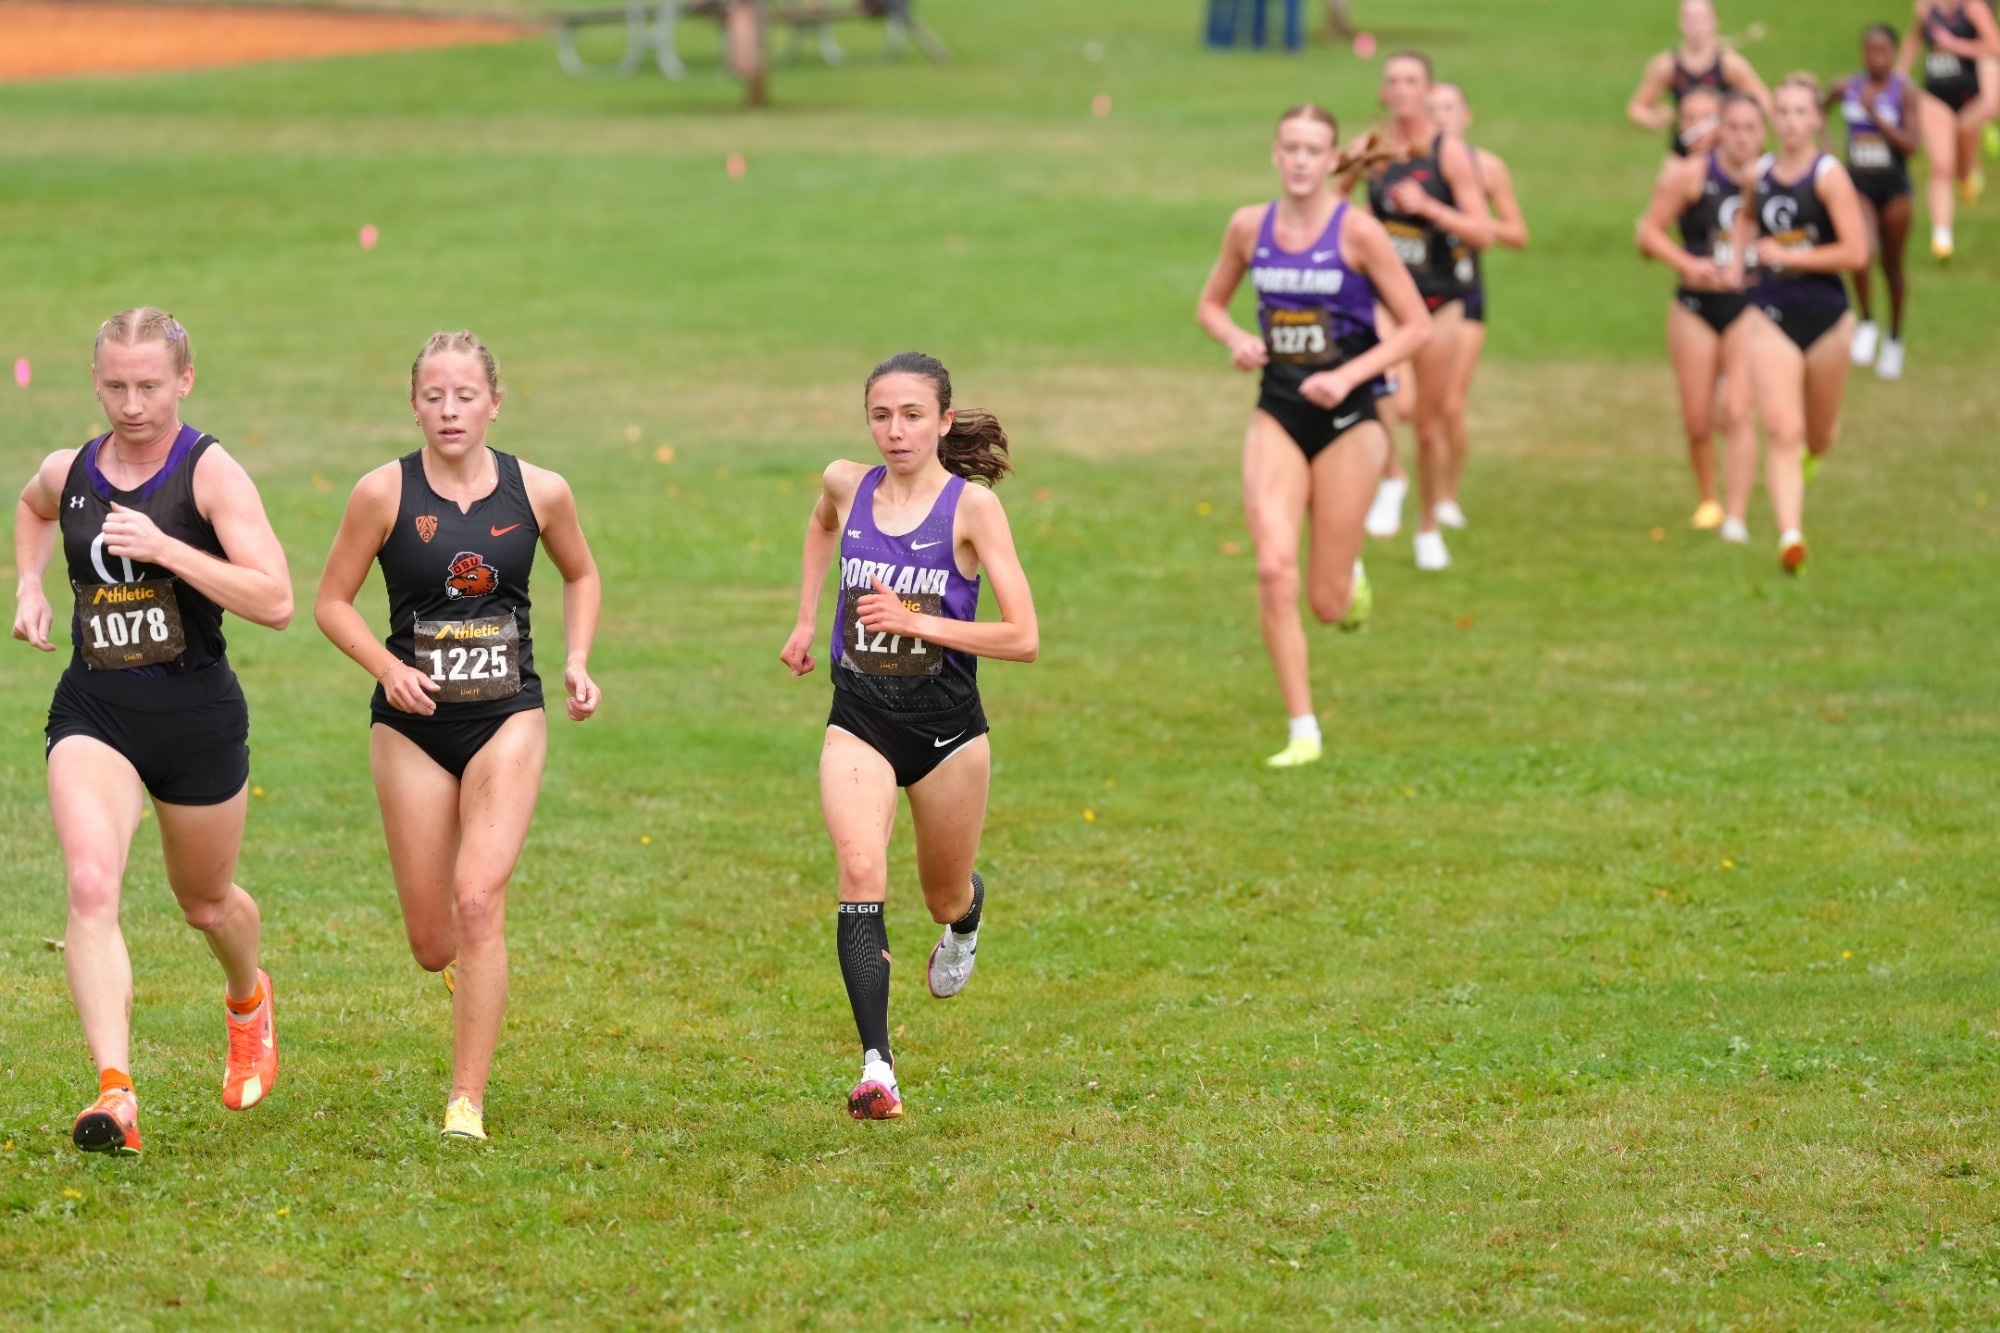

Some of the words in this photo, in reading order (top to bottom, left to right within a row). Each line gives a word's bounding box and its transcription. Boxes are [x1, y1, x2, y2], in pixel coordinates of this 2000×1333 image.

[1271, 324, 1327, 353] 1273
[453, 557, 480, 575] OSU
[840, 556, 950, 597] PORTLAND
[92, 585, 155, 605] Athletic
[90, 607, 169, 649] 1078
[434, 623, 500, 640] Athletic
[429, 645, 509, 681] 1225
